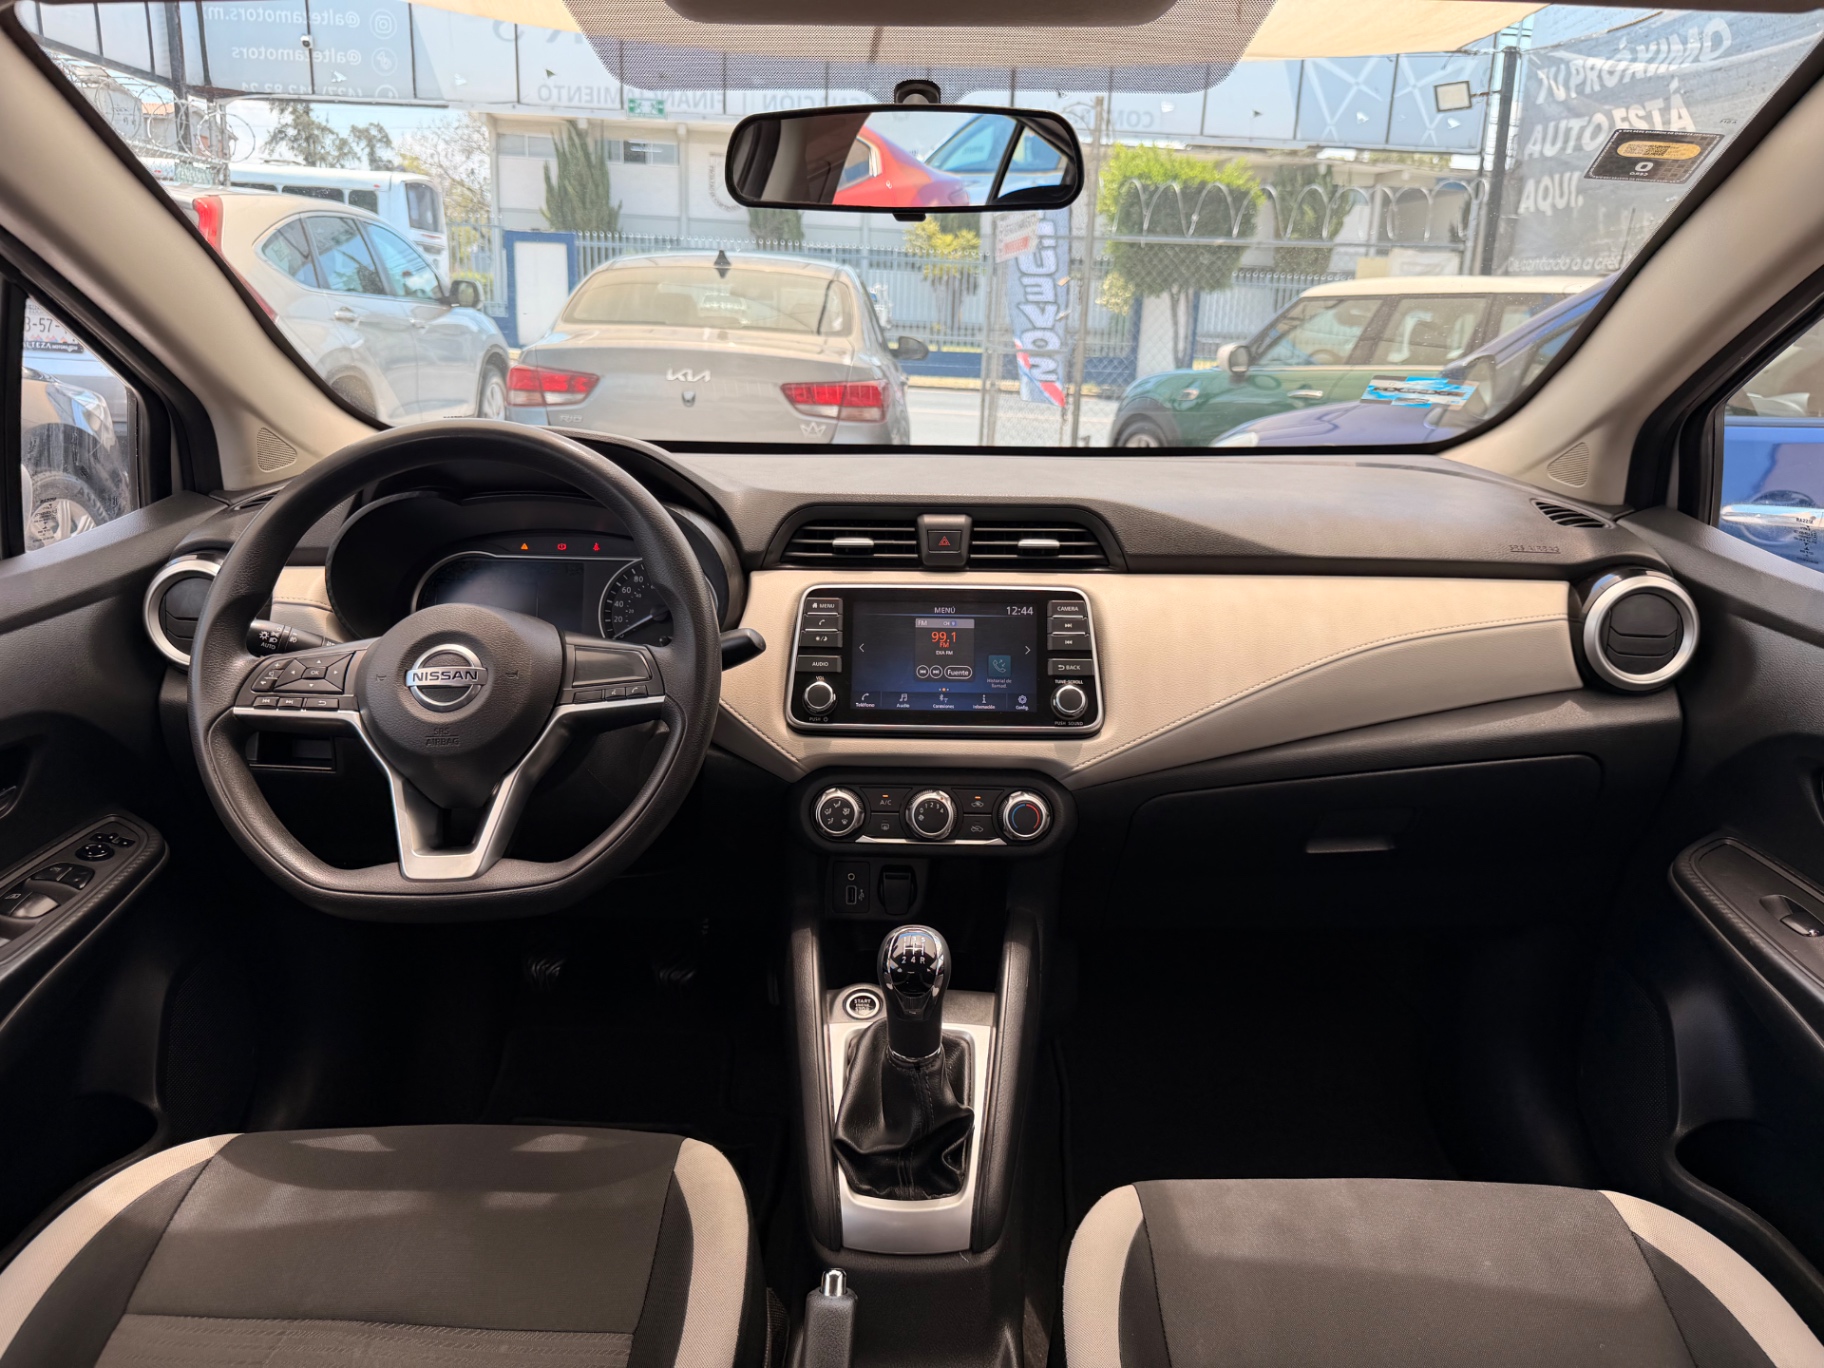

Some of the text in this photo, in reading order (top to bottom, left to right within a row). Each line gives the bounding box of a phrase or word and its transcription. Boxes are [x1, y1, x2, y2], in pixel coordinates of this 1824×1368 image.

[1535, 17, 1732, 105] TU PRÓXIMO
[1524, 77, 1696, 160] AUTO ESTÁ
[633, 575, 644, 583] 80
[621, 586, 632, 594] 60
[934, 606, 956, 614] MENÚ
[1006, 606, 1034, 616] 12:44
[931, 631, 957, 643] 99.1
[260, 641, 276, 650] AUTO
[412, 670, 479, 682] NISSAN
[434, 728, 450, 736] SRS
[425, 737, 460, 746] AIRBAG
[919, 956, 926, 964] R
